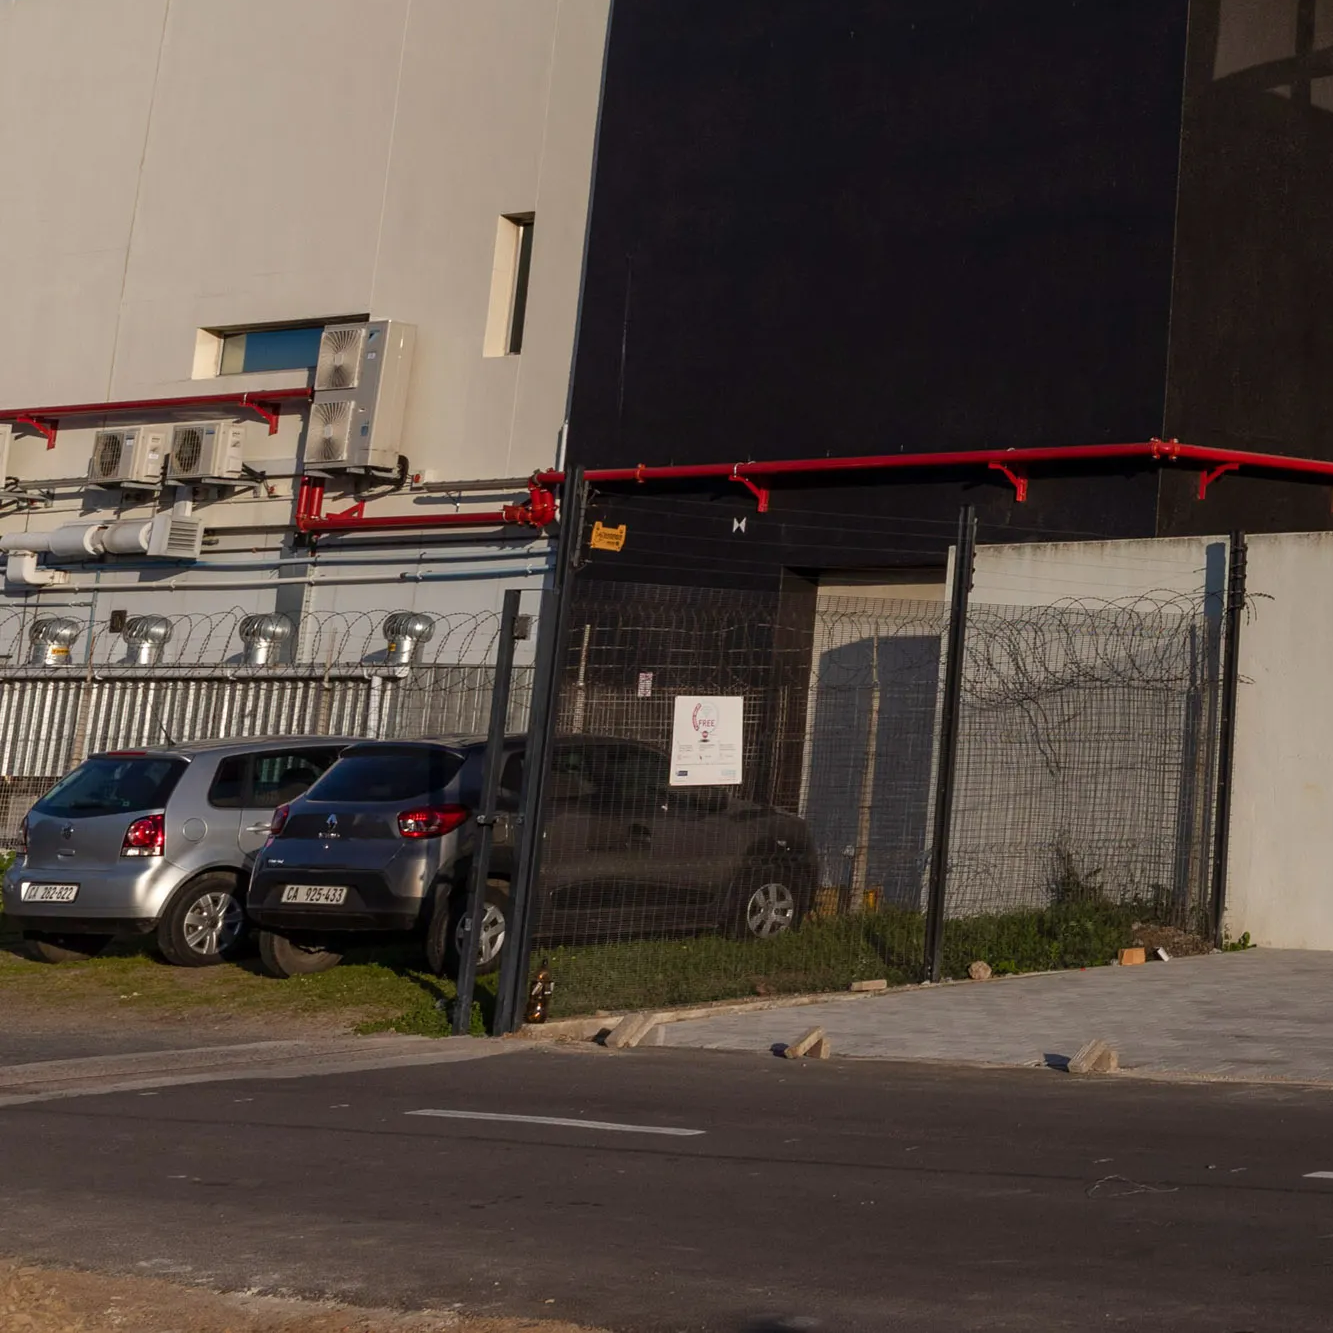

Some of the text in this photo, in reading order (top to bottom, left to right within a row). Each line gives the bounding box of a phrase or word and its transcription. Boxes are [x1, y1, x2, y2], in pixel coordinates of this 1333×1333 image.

[699, 719, 715, 727] FREE
[28, 887, 39, 900] CA
[286, 886, 344, 903] CA 925-433
